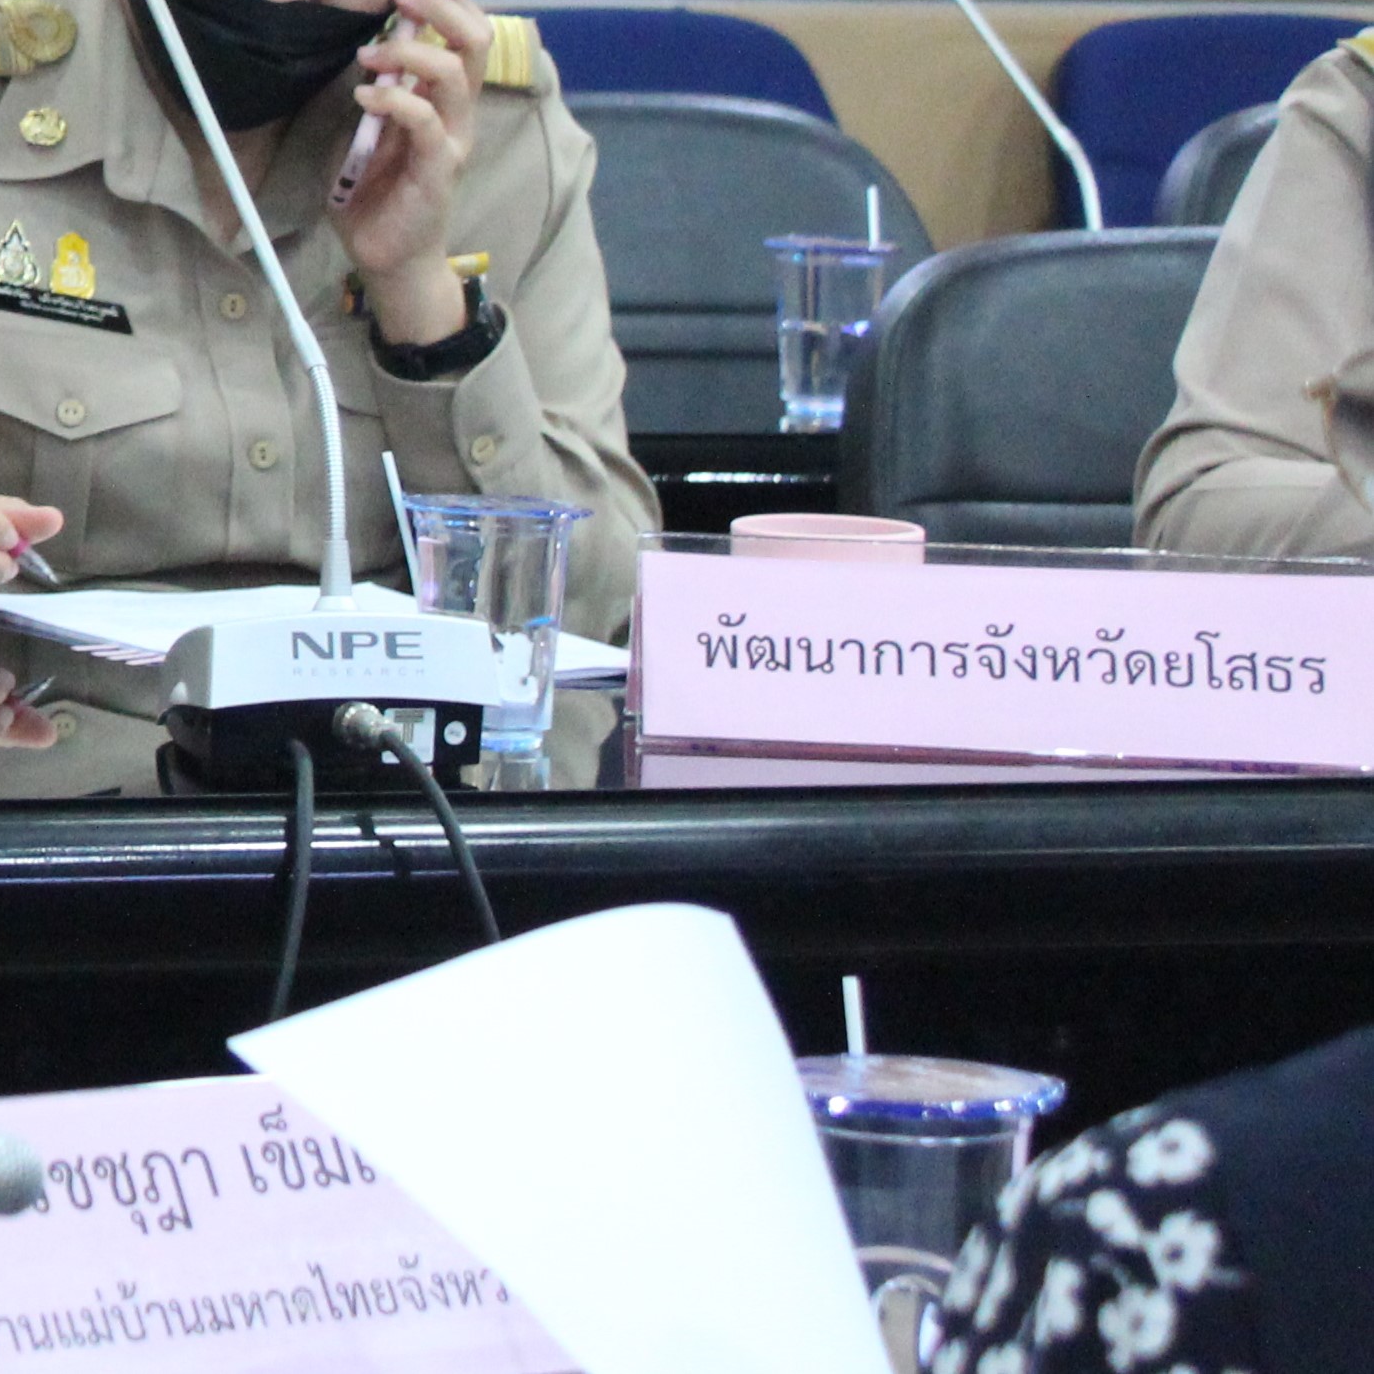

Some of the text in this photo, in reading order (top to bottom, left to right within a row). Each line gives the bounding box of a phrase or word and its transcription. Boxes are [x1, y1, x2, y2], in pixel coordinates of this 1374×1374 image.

[291, 631, 424, 660] NPE
[697, 613, 1328, 696] พัฒนาการจังหวัดยโสธร
[292, 666, 425, 677] RESEARCH
